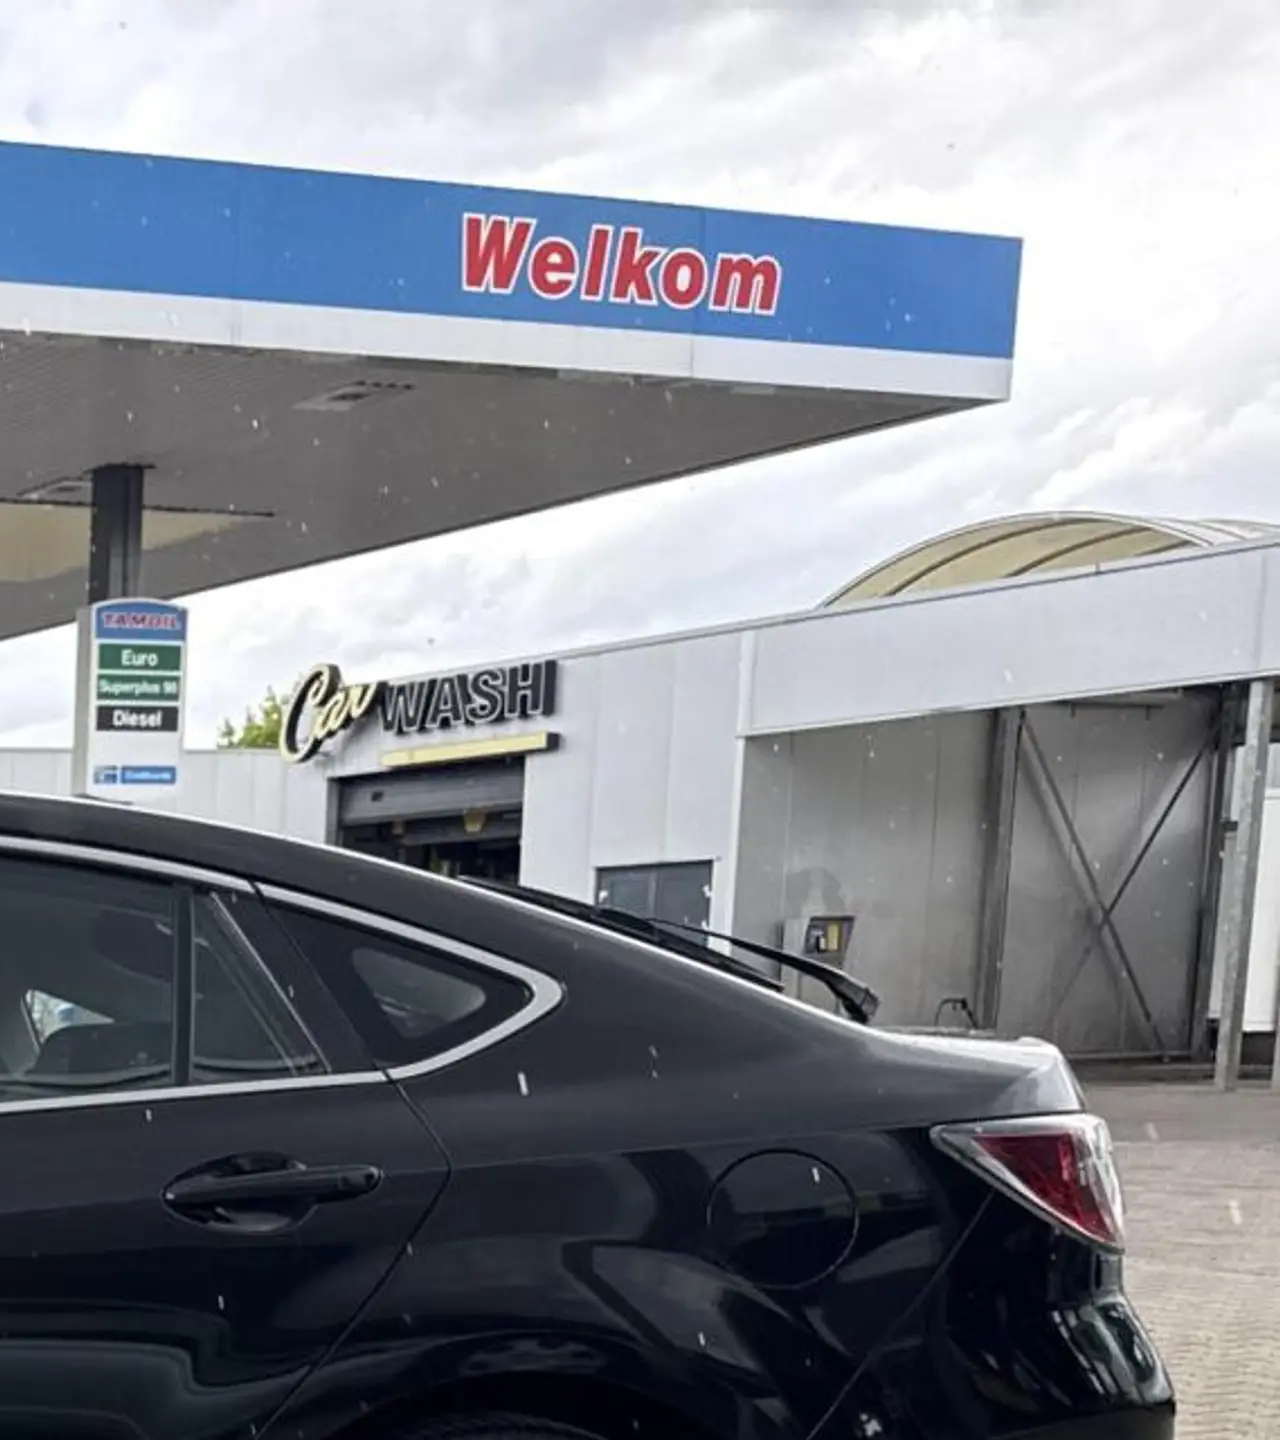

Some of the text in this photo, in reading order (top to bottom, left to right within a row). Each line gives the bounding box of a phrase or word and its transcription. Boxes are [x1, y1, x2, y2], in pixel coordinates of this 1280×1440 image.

[462, 212, 783, 316] Welkom
[102, 612, 180, 630] TAMOIL
[121, 649, 158, 666] Euro
[113, 709, 162, 728] Diesel
[280, 659, 557, 763] Car WASH
